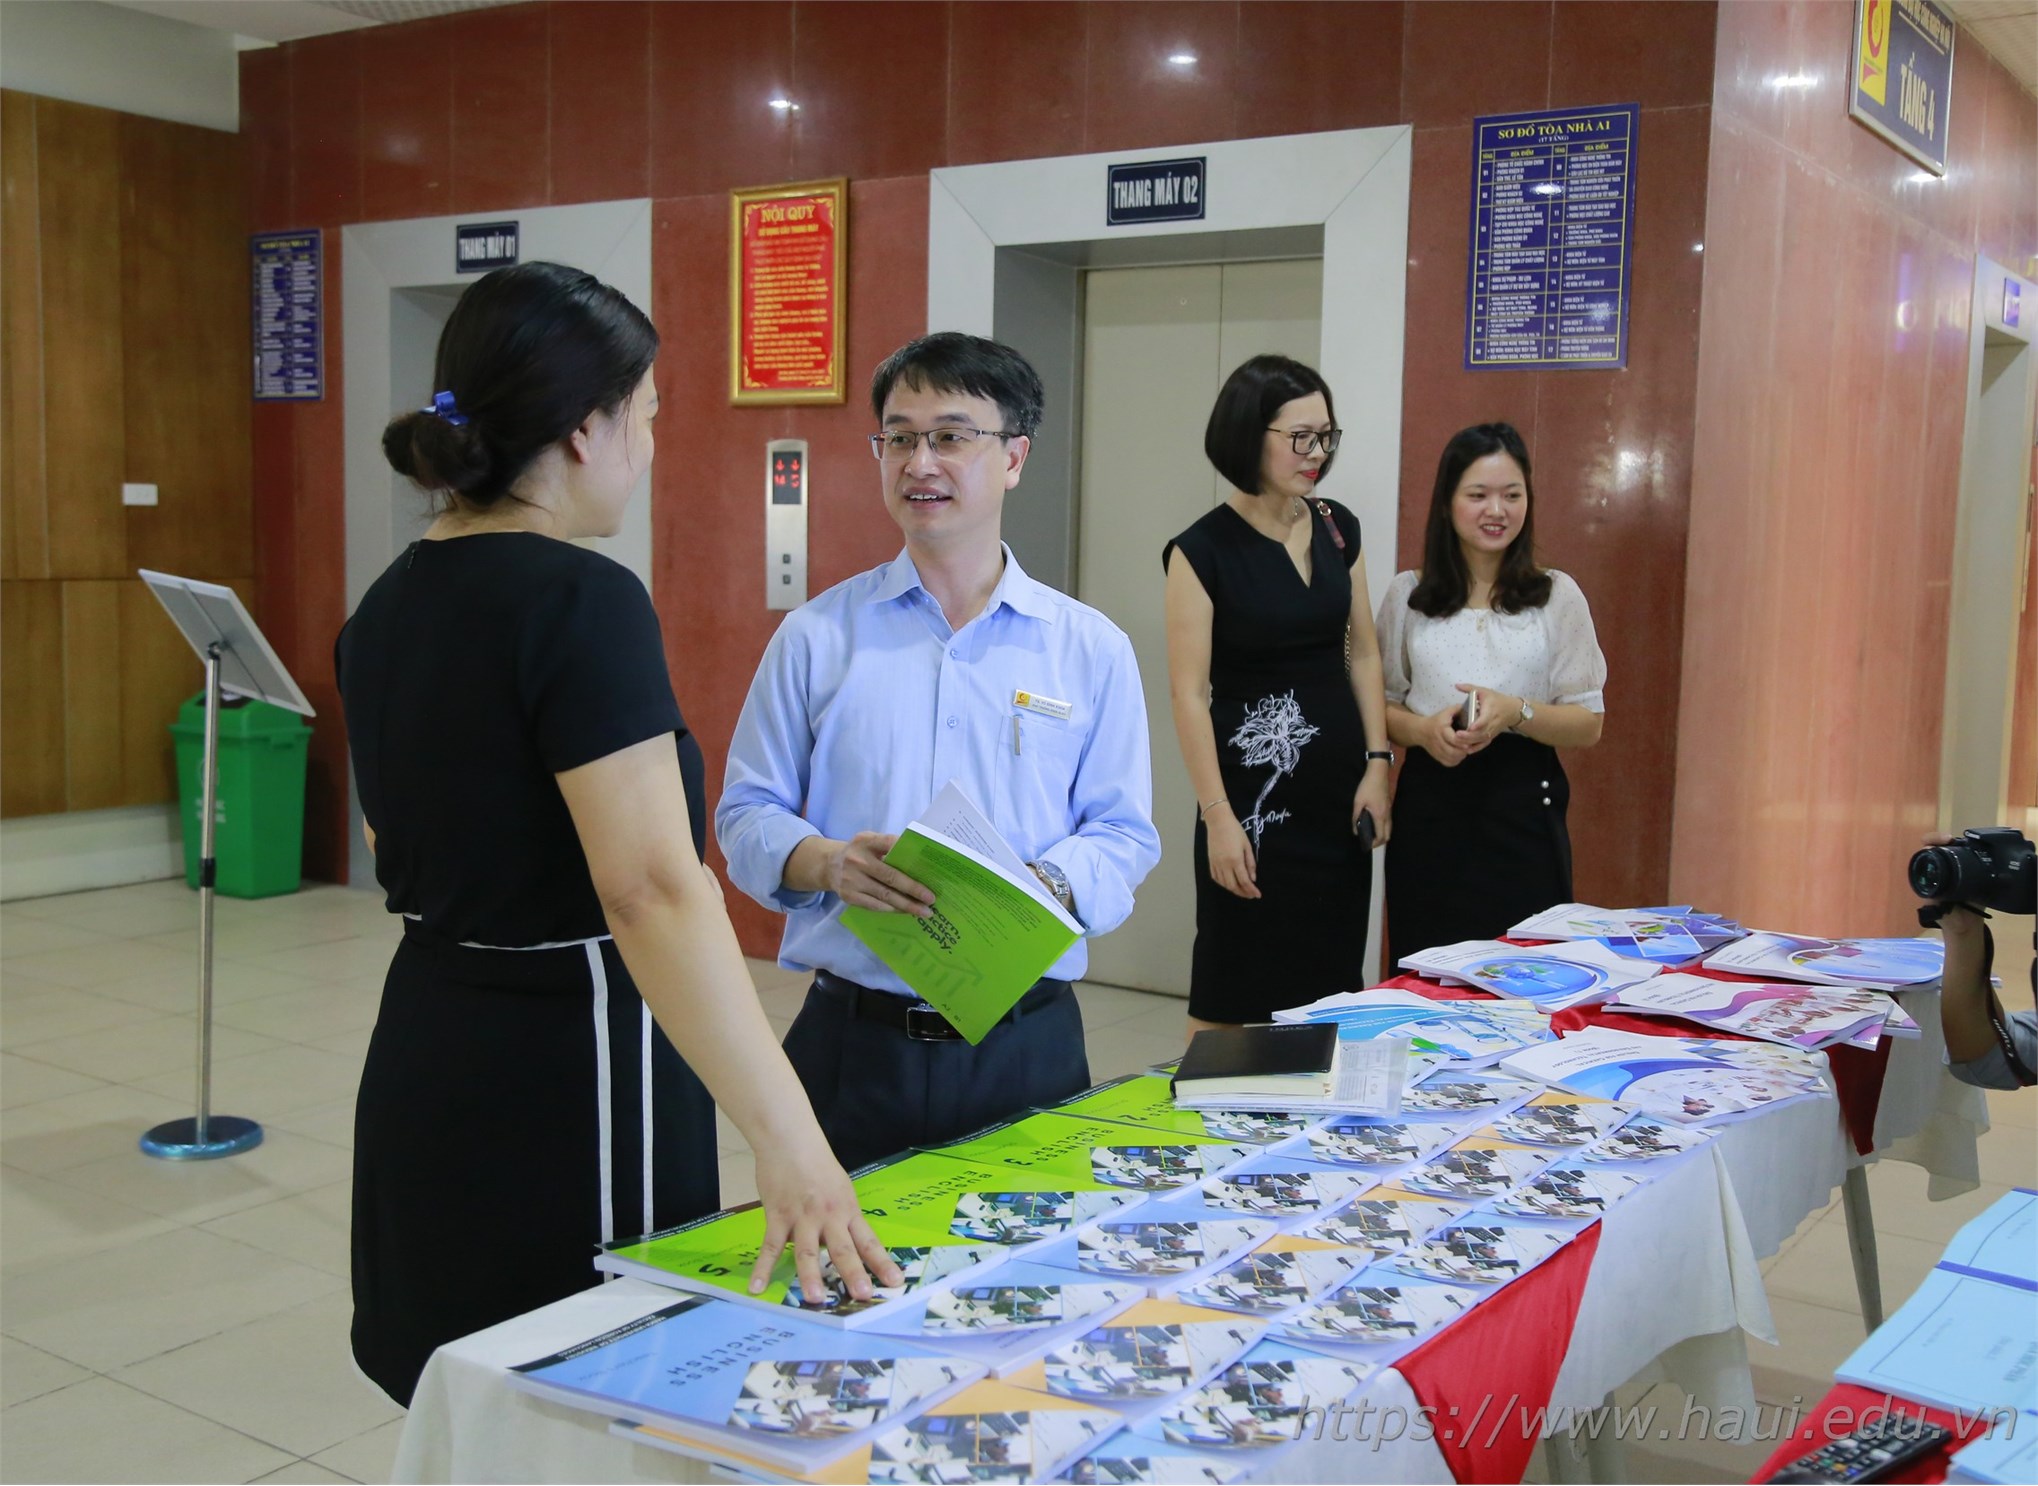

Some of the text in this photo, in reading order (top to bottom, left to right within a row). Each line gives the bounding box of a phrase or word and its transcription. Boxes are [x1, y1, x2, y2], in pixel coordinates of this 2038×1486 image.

[1900, 52, 1935, 141] TẦNG 4
[1498, 128, 1514, 140] SƠ
[1517, 124, 1535, 138] ĐỒ
[1538, 123, 1564, 136] TÒA
[1566, 120, 1593, 133] NHÀ
[1113, 171, 1198, 209] THANG MÁY 02
[761, 204, 784, 225] NỘI
[460, 237, 486, 260] THANG
[486, 231, 505, 259] MÁY
[917, 917, 952, 954] apply.
[929, 904, 960, 939] earn,
[1030, 1127, 1098, 1156] ENGLISH
[1036, 1129, 1114, 1162] BUSINESS
[1002, 1158, 1033, 1167] 3
[893, 1170, 977, 1204] ENGLISH
[896, 1173, 992, 1212] BUSINESS
[698, 1264, 732, 1278] 5
[666, 1326, 777, 1376] ENGLISH
[669, 1330, 795, 1386] BUSINESS
